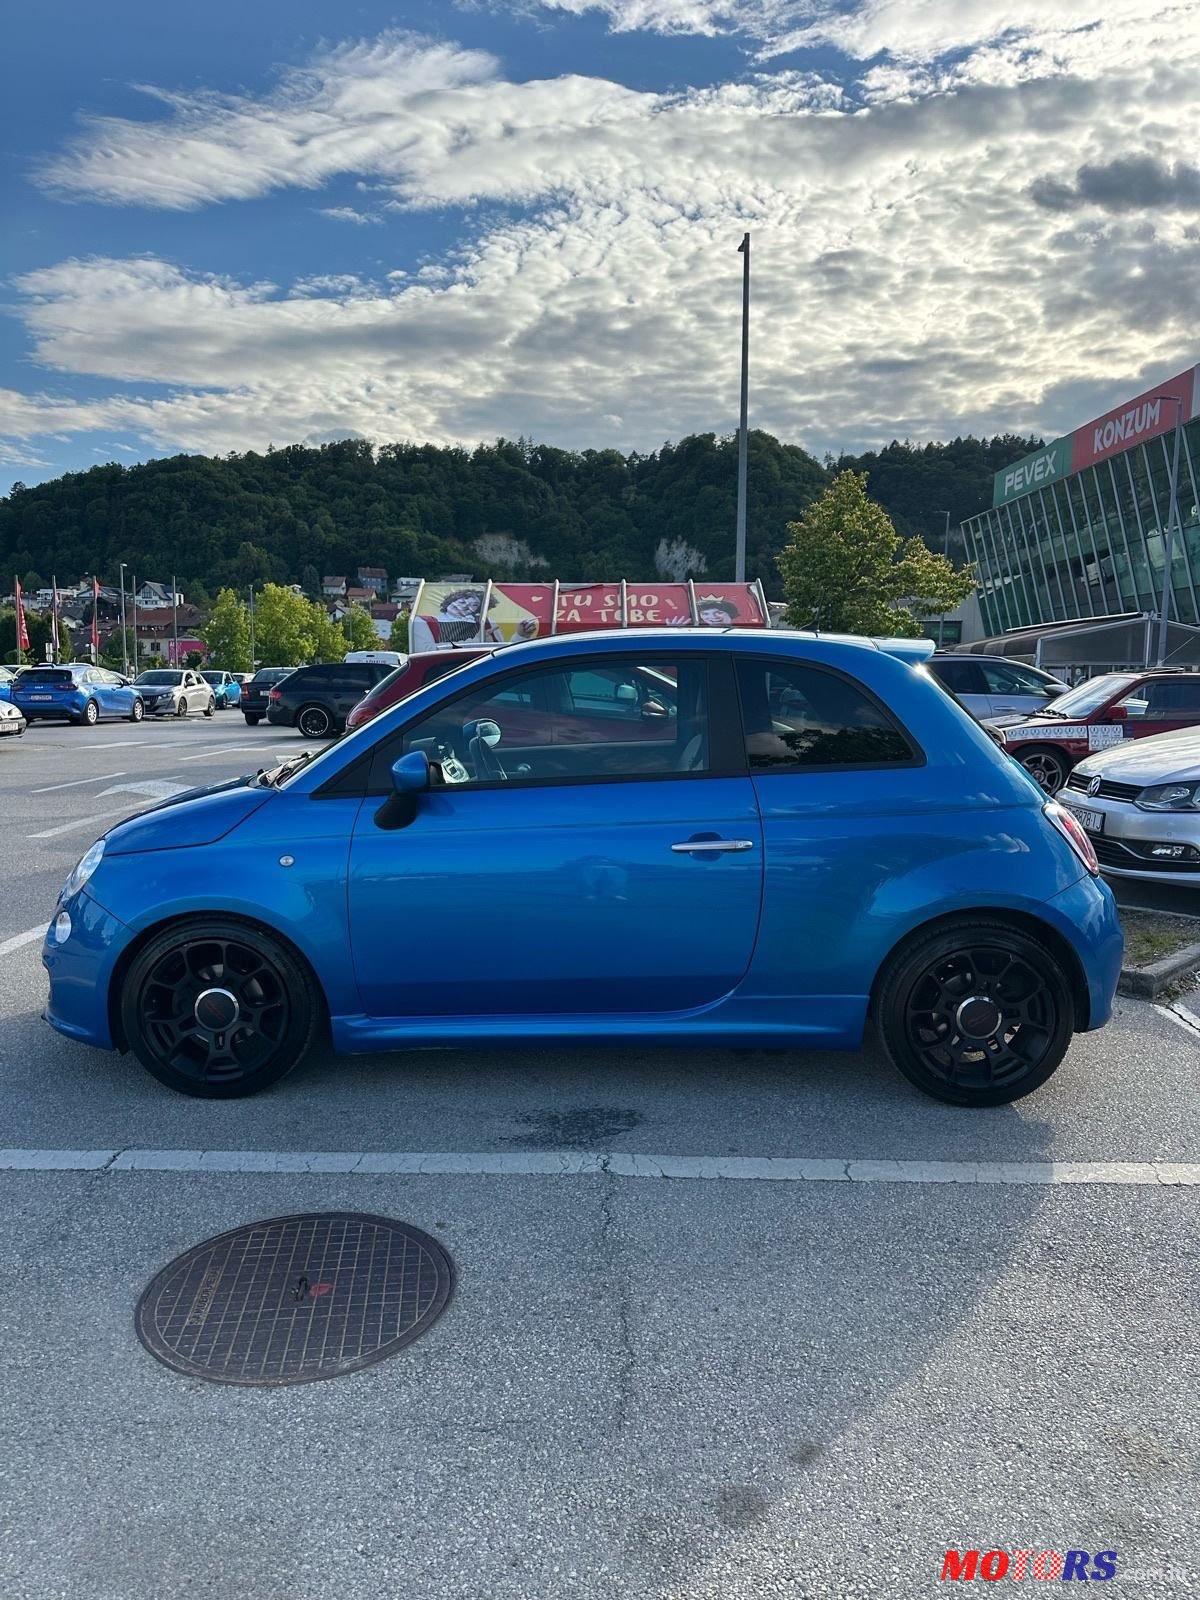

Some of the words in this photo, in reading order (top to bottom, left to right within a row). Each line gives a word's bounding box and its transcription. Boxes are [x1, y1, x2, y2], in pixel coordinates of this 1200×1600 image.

[1093, 399, 1161, 454] KONZUM
[1004, 450, 1057, 497] PEVEX
[555, 609, 581, 622] ZA
[557, 594, 593, 607] TU
